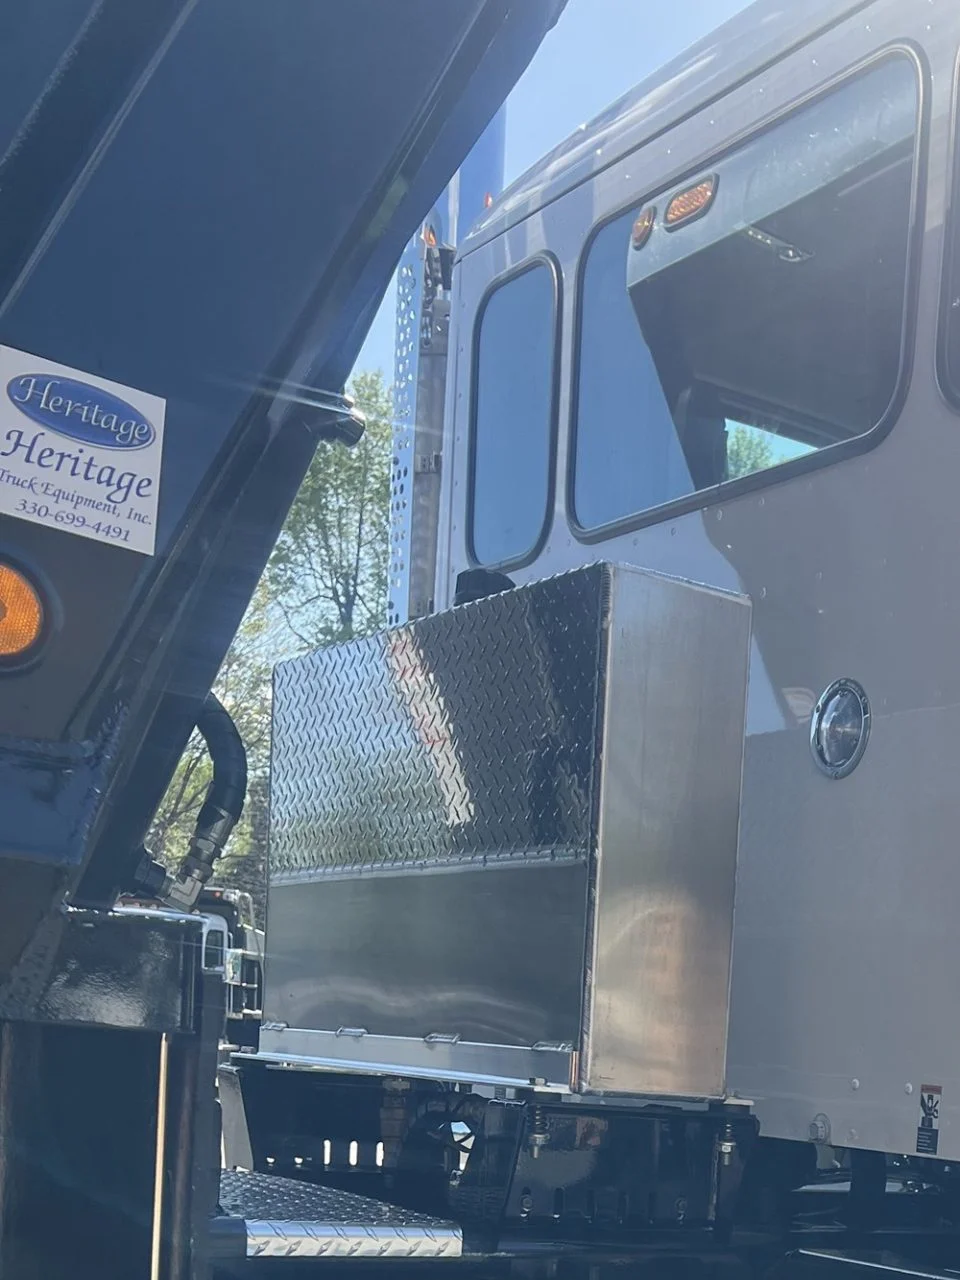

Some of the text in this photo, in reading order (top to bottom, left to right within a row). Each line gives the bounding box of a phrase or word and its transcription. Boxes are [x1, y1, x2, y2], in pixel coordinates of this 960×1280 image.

[14, 376, 149, 445] Heritage
[0, 429, 152, 504] Heritage
[0, 467, 152, 526] Truck Equipment, Inc.
[14, 498, 130, 542] 330-699-4491
